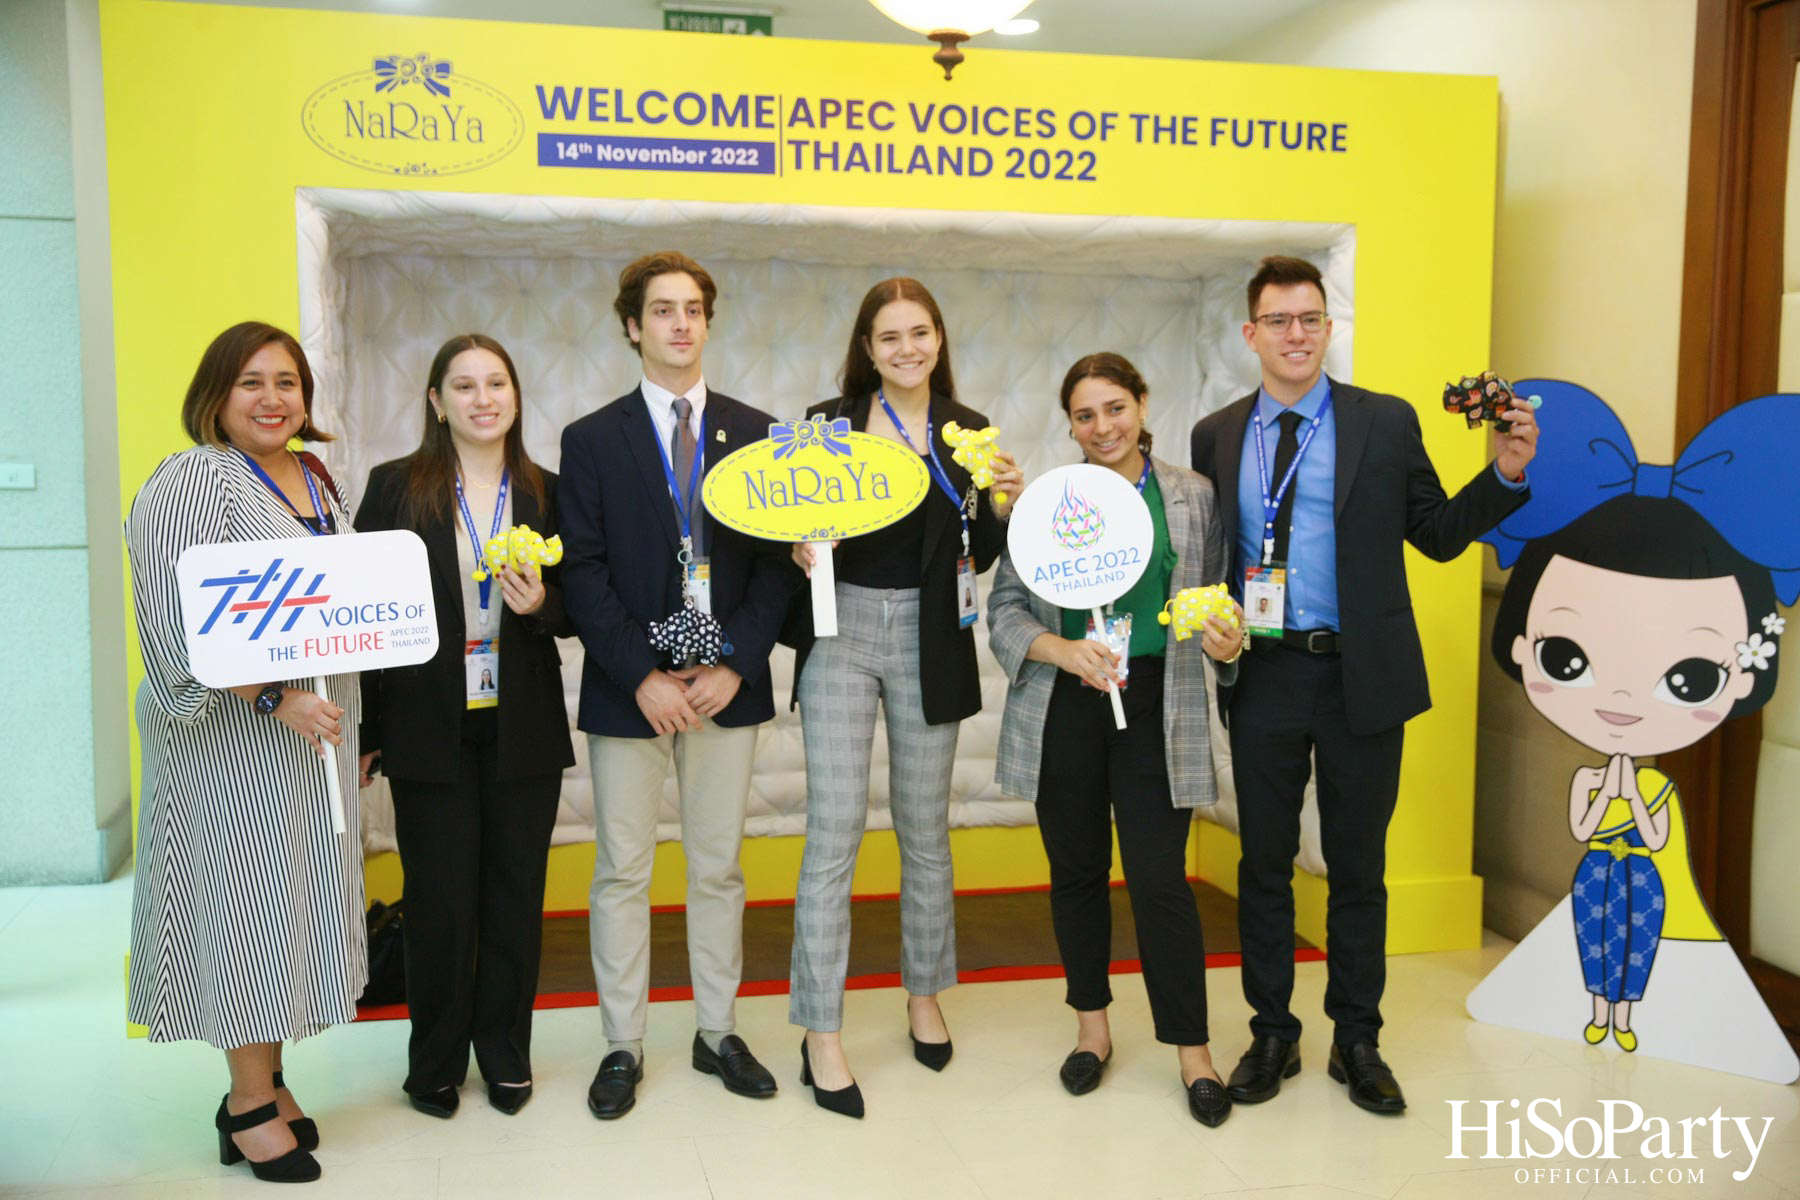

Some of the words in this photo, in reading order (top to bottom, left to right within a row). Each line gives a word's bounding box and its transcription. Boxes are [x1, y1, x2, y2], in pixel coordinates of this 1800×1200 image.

[344, 100, 486, 144] NaRaYa
[535, 84, 776, 129] WELCOME
[787, 97, 896, 132] APEC
[908, 102, 1057, 140] VOICES
[1067, 110, 1120, 142] OF
[1128, 112, 1200, 147] THE
[1209, 116, 1349, 154] FUTURE
[556, 142, 593, 160] 14th
[596, 145, 707, 166] November
[710, 147, 760, 166] 2022
[787, 138, 995, 177] THAILAND
[1004, 146, 1098, 182] 2022
[742, 462, 893, 511] NaRaYa
[1033, 557, 1089, 583] APEC
[1092, 547, 1141, 571] 2022
[1053, 570, 1126, 593] THAILAND
[319, 601, 399, 628] VOICES
[405, 604, 426, 619] OF
[267, 645, 298, 662] THE
[304, 631, 385, 658] FUTURE
[390, 629, 410, 637] APEC
[411, 626, 429, 634] 2022
[391, 637, 430, 648] THAILAND
